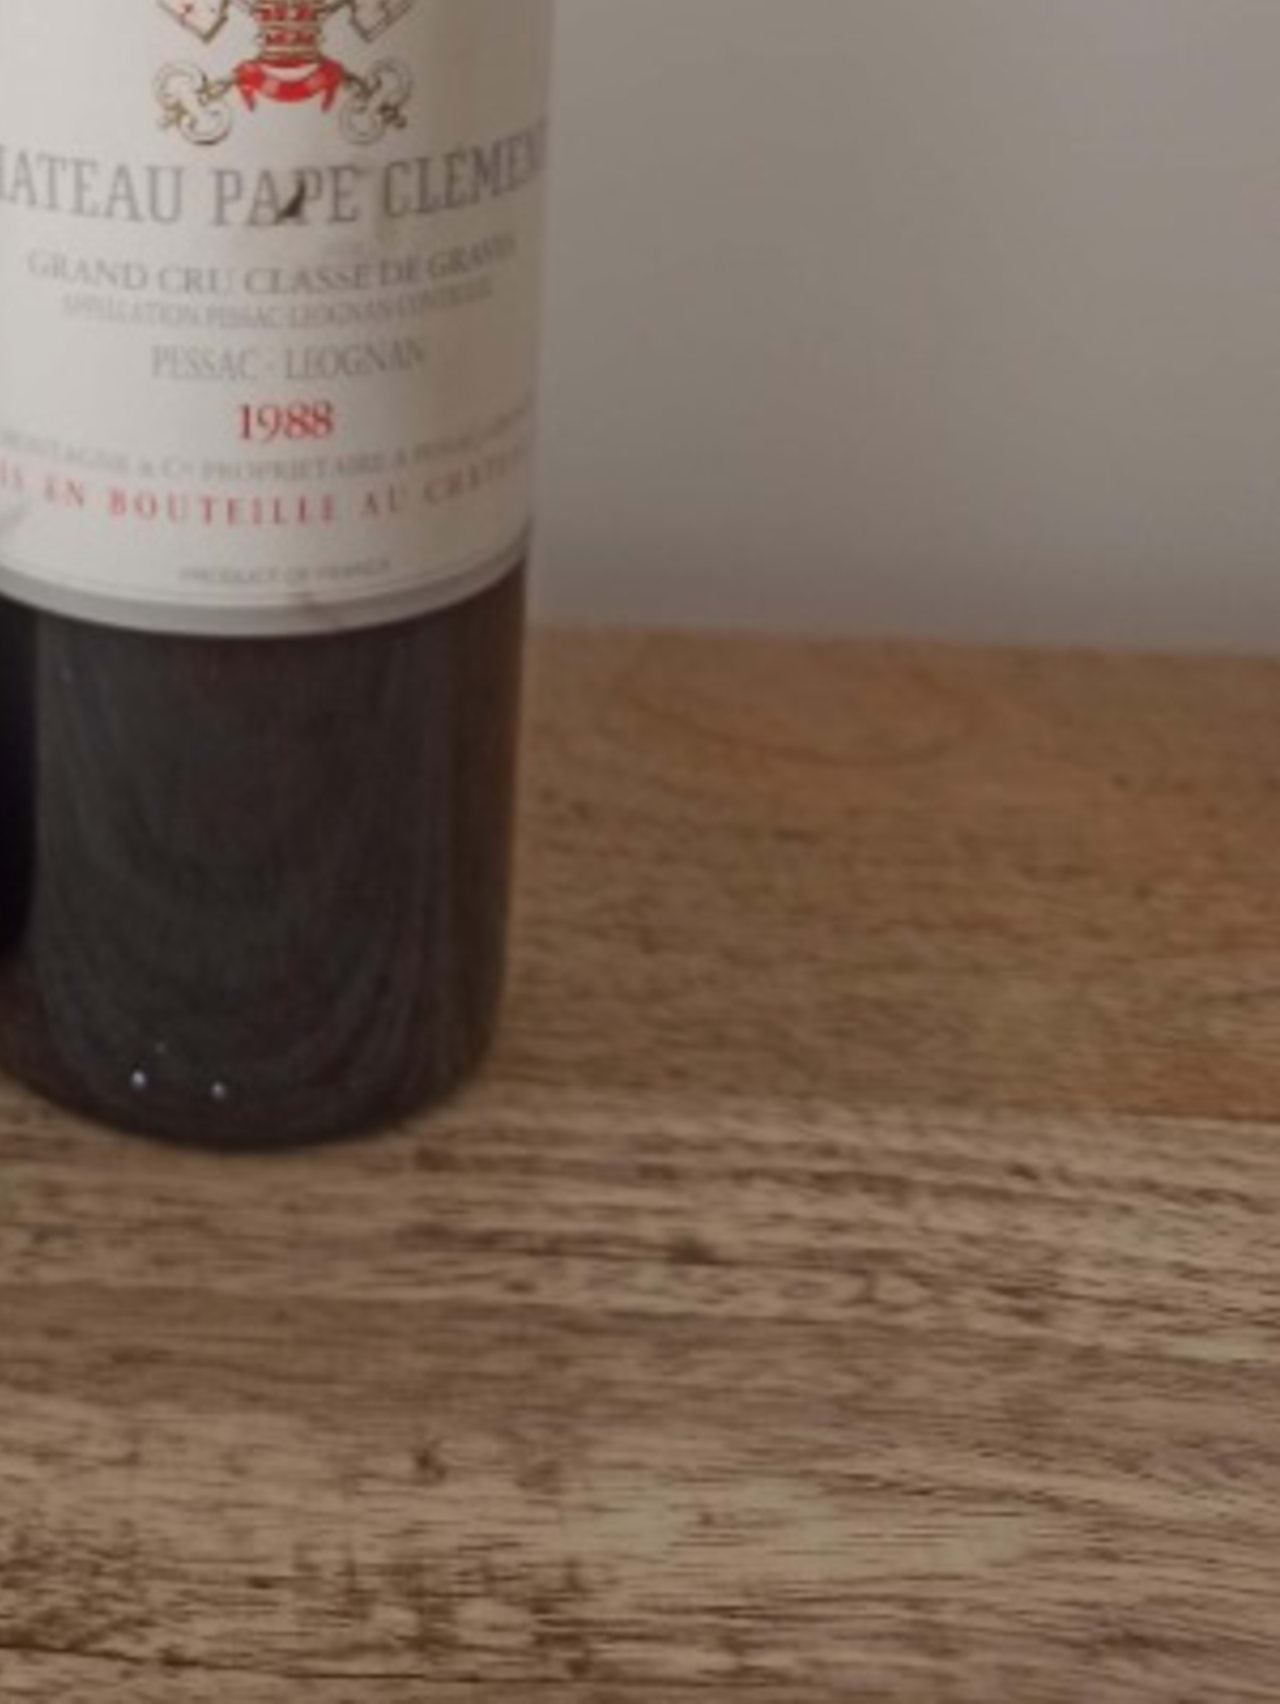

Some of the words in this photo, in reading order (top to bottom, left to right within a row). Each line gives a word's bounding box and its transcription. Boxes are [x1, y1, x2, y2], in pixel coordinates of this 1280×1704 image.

[210, 163, 363, 228] PAPE
[26, 247, 150, 293] GRAND
[156, 264, 236, 296] CRU
[150, 344, 262, 382] PESSAC
[238, 400, 336, 444] 1988
[43, 474, 86, 510] EN
[107, 484, 335, 527] BOUTEILLE
